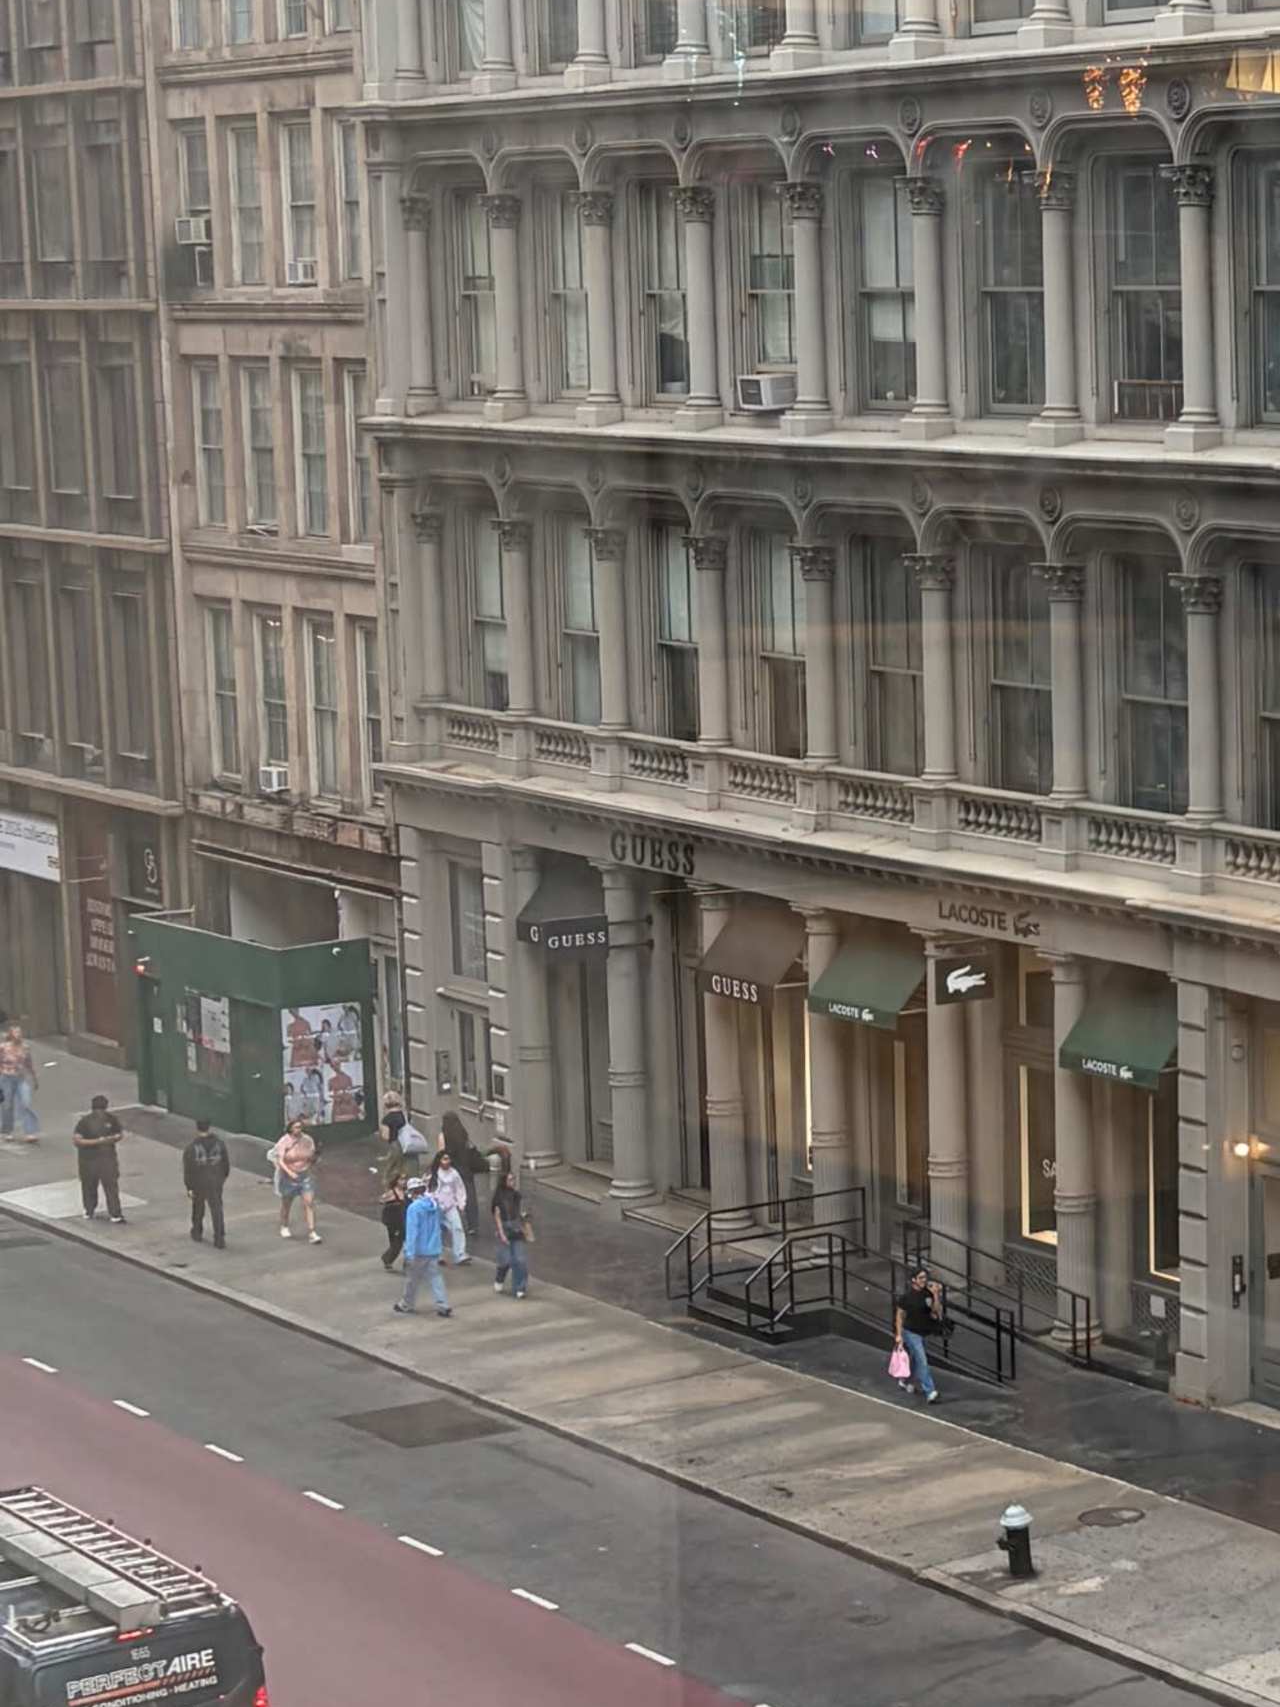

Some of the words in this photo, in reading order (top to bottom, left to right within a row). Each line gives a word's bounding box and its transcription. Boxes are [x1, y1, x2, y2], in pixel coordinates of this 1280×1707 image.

[611, 830, 695, 876] GUESS
[939, 900, 1007, 931] LACOSTE
[547, 930, 606, 949] GUESS
[712, 975, 758, 1003] GUESS
[828, 1002, 860, 1020] LACOSTE
[1082, 1058, 1117, 1076] LACOSTE
[173, 1675, 218, 1694] HEATING
